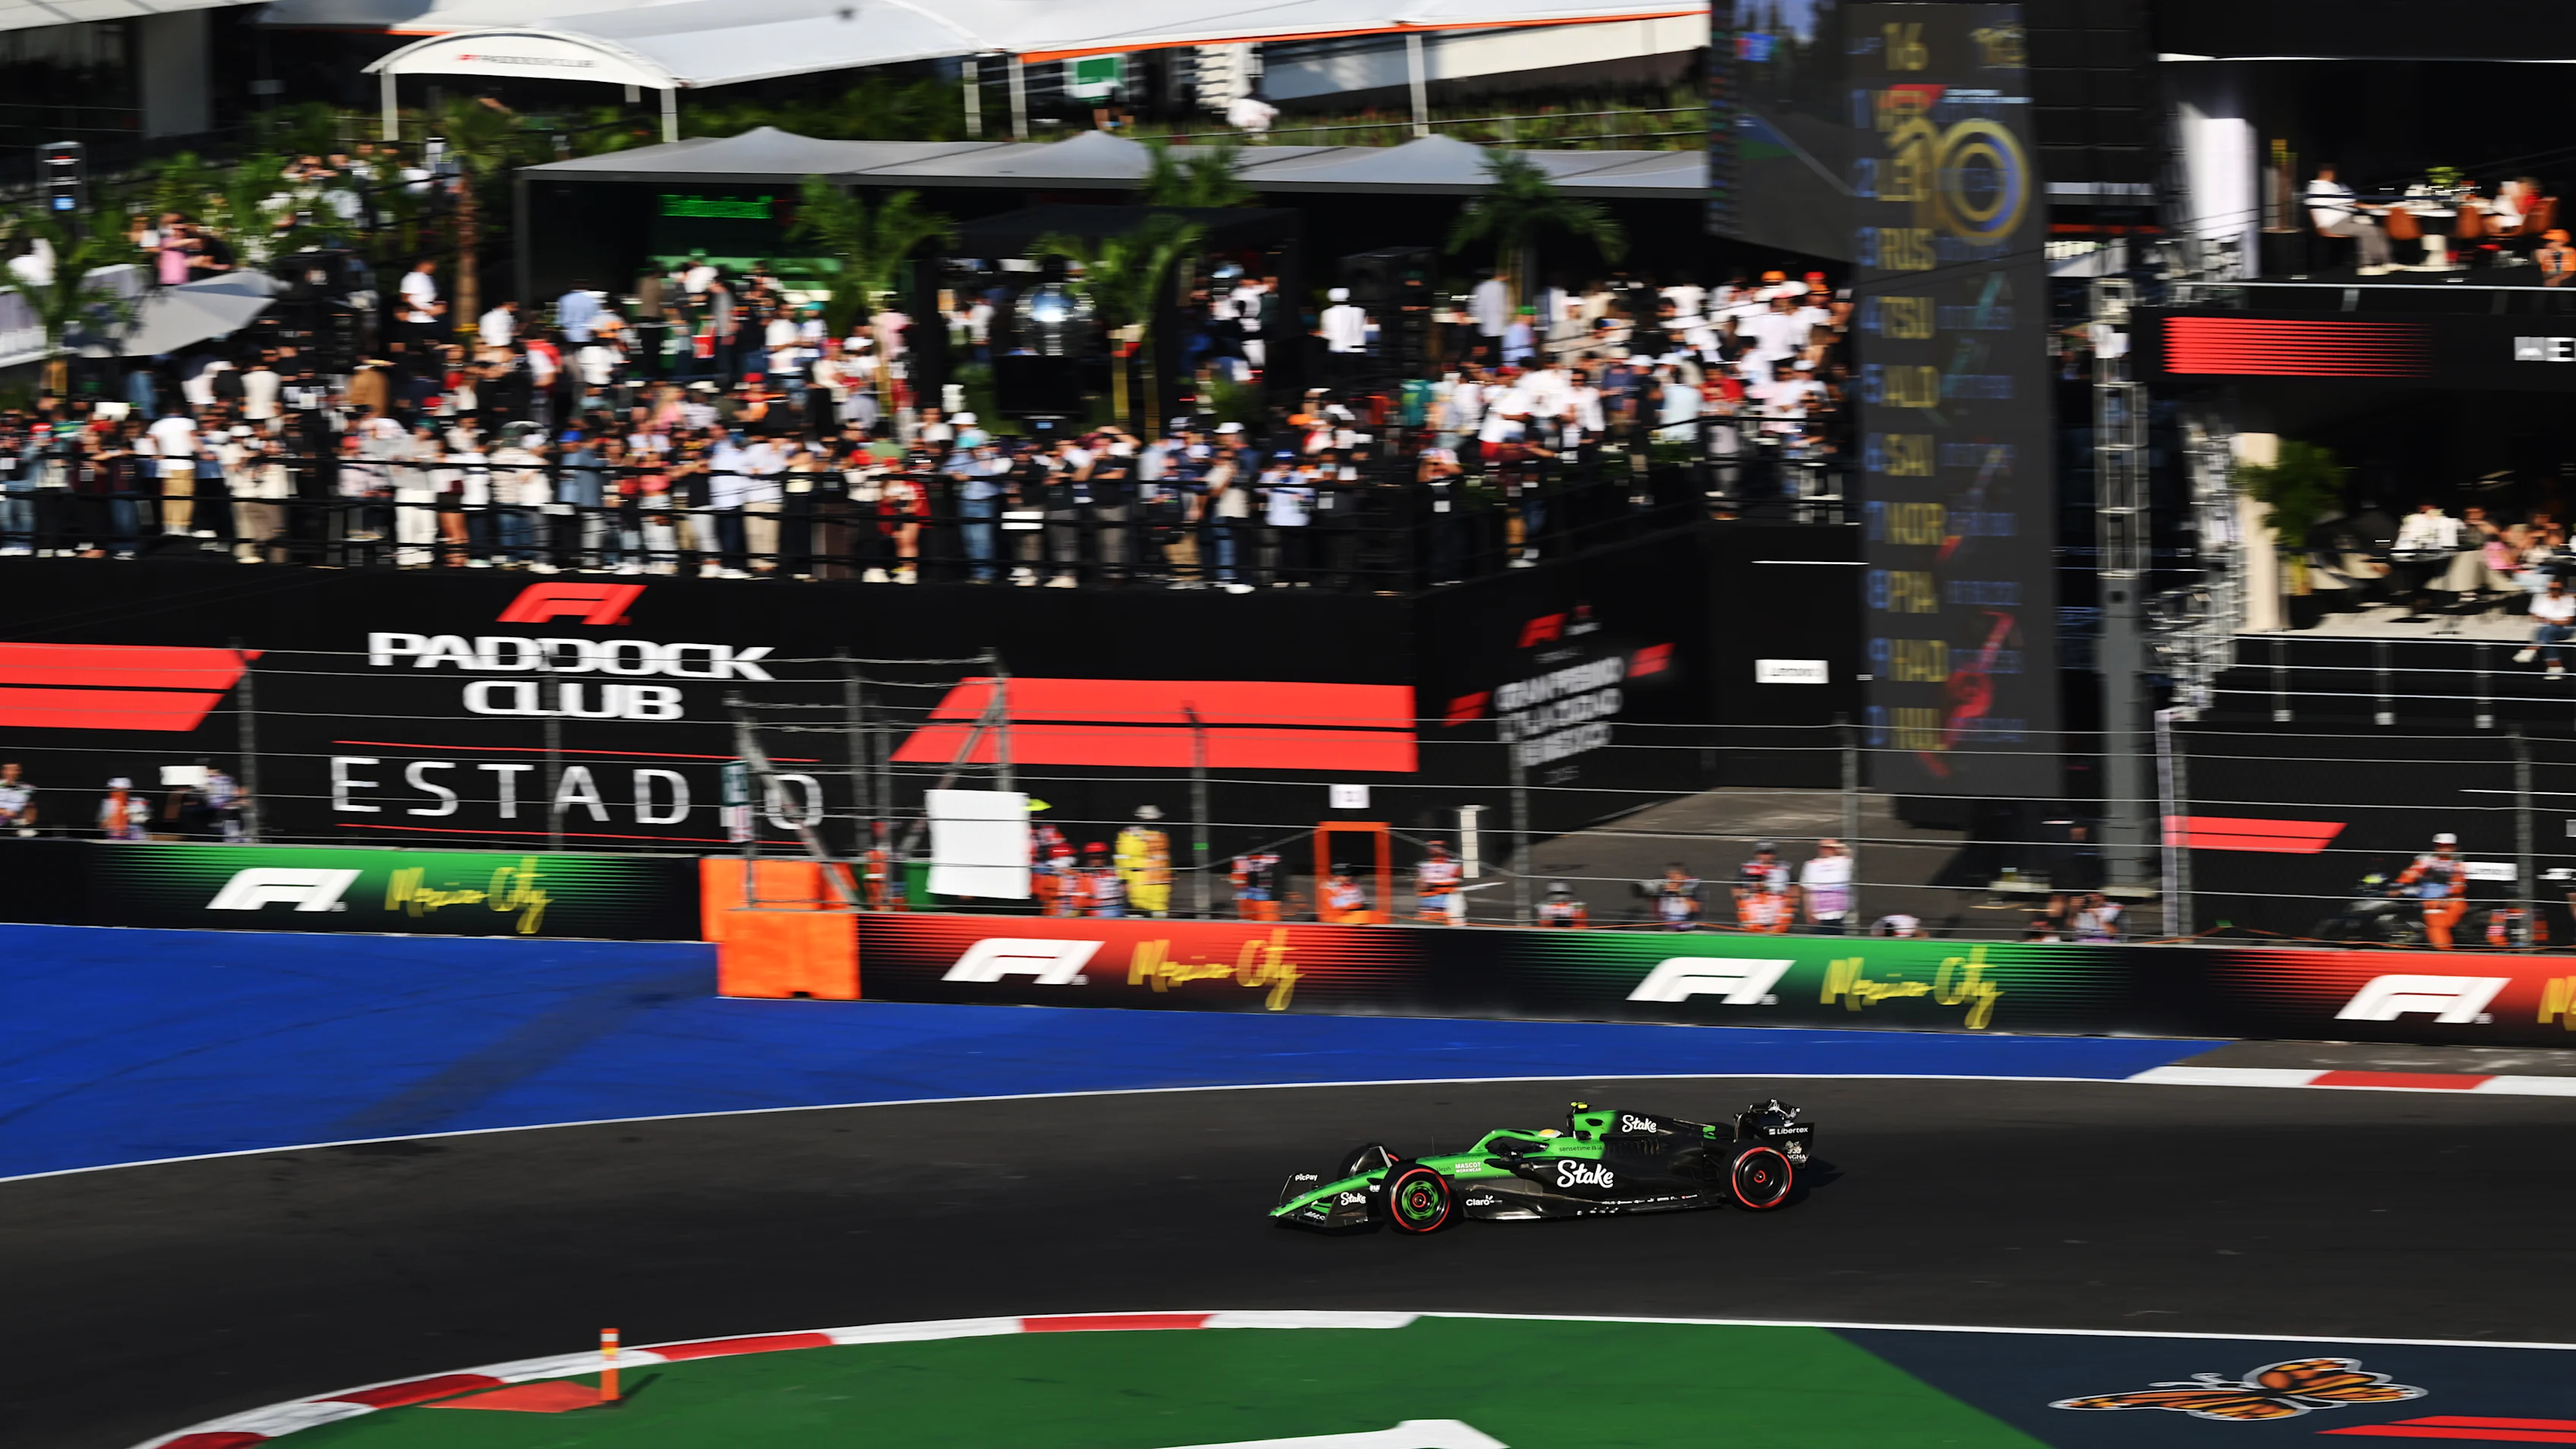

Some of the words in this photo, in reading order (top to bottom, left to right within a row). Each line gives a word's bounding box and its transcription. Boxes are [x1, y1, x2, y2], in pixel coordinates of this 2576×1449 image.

[1881, 23, 1928, 70] 16
[368, 632, 776, 680] PADDOCK
[462, 680, 684, 721] CLUB
[330, 756, 824, 830] ESTADO
[488, 855, 554, 934] City
[1236, 928, 1305, 1011] City
[1934, 945, 2006, 1030] City
[1621, 1114, 1657, 1133] Stake
[1557, 1159, 1615, 1189] Stake
[1340, 1192, 1366, 1206] Stake
